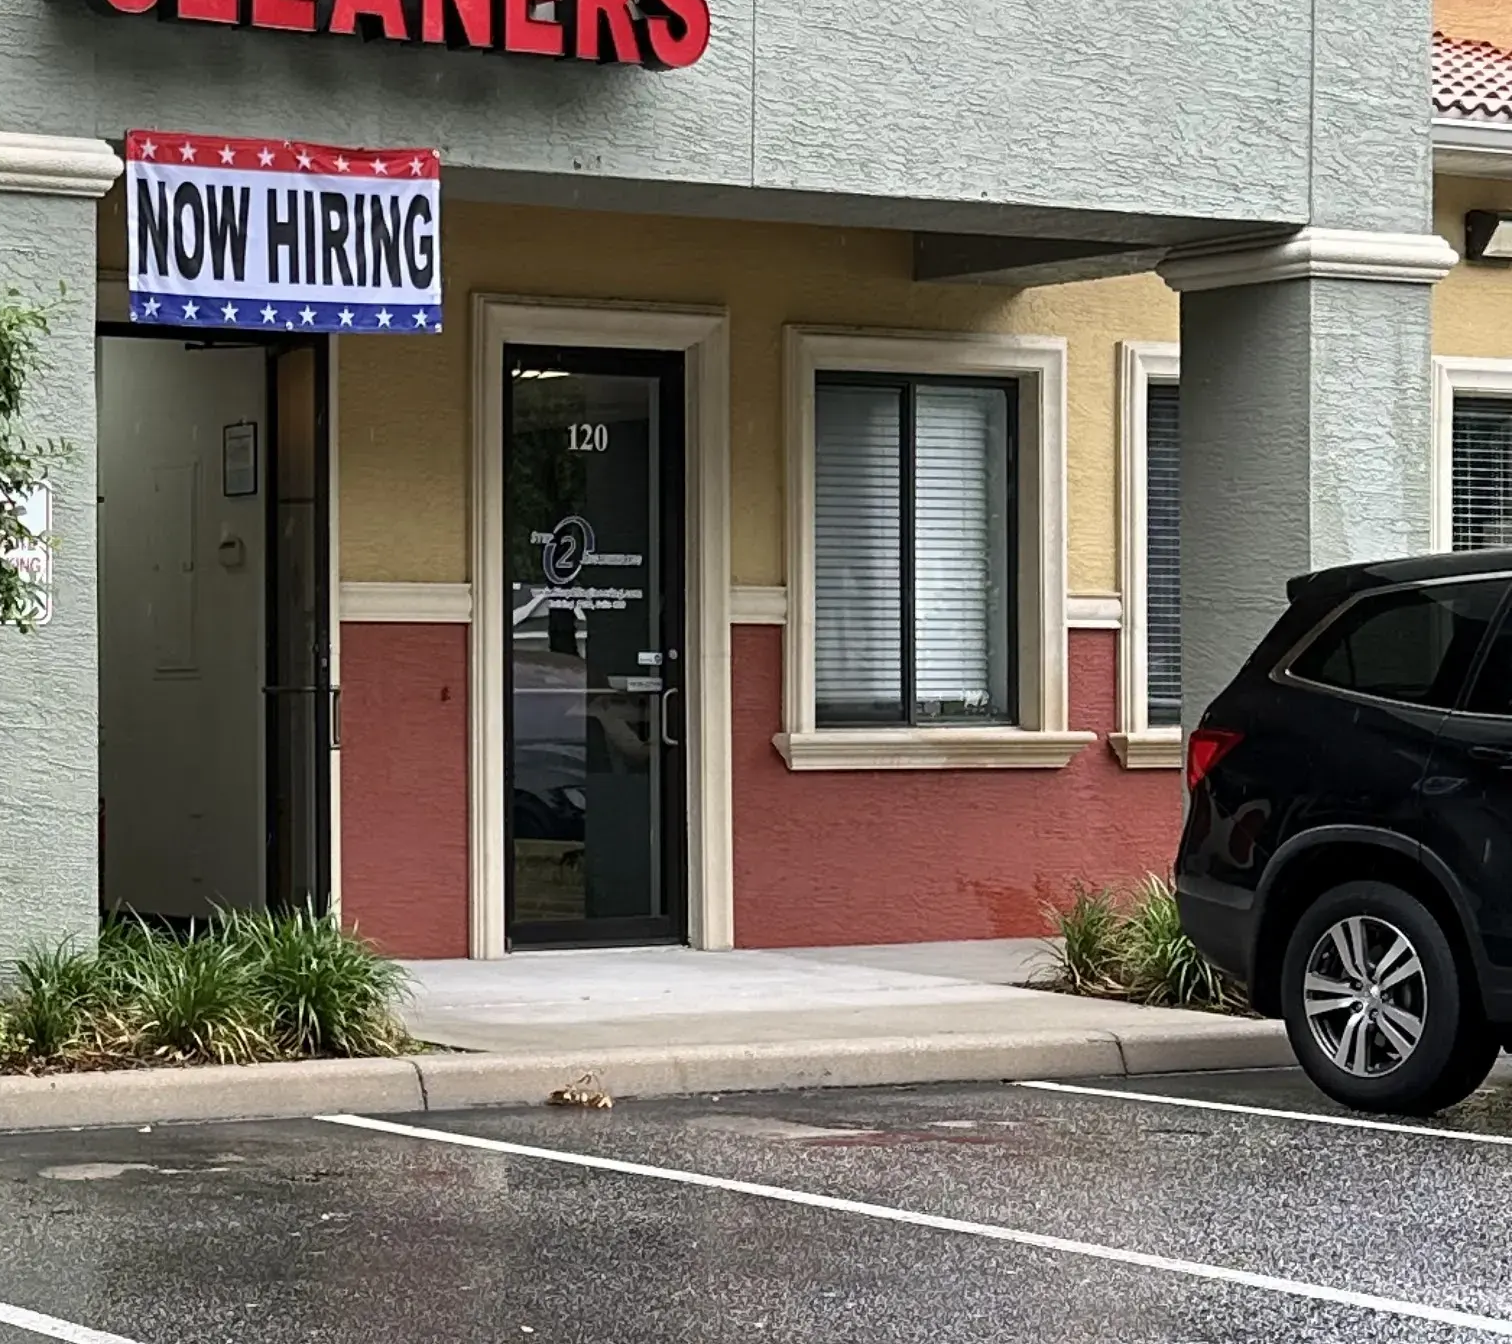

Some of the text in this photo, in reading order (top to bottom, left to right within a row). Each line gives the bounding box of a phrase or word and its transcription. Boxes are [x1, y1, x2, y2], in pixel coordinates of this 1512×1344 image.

[137, 177, 435, 290] NOW HIRING
[568, 423, 608, 452] 120
[555, 536, 576, 568] 2
